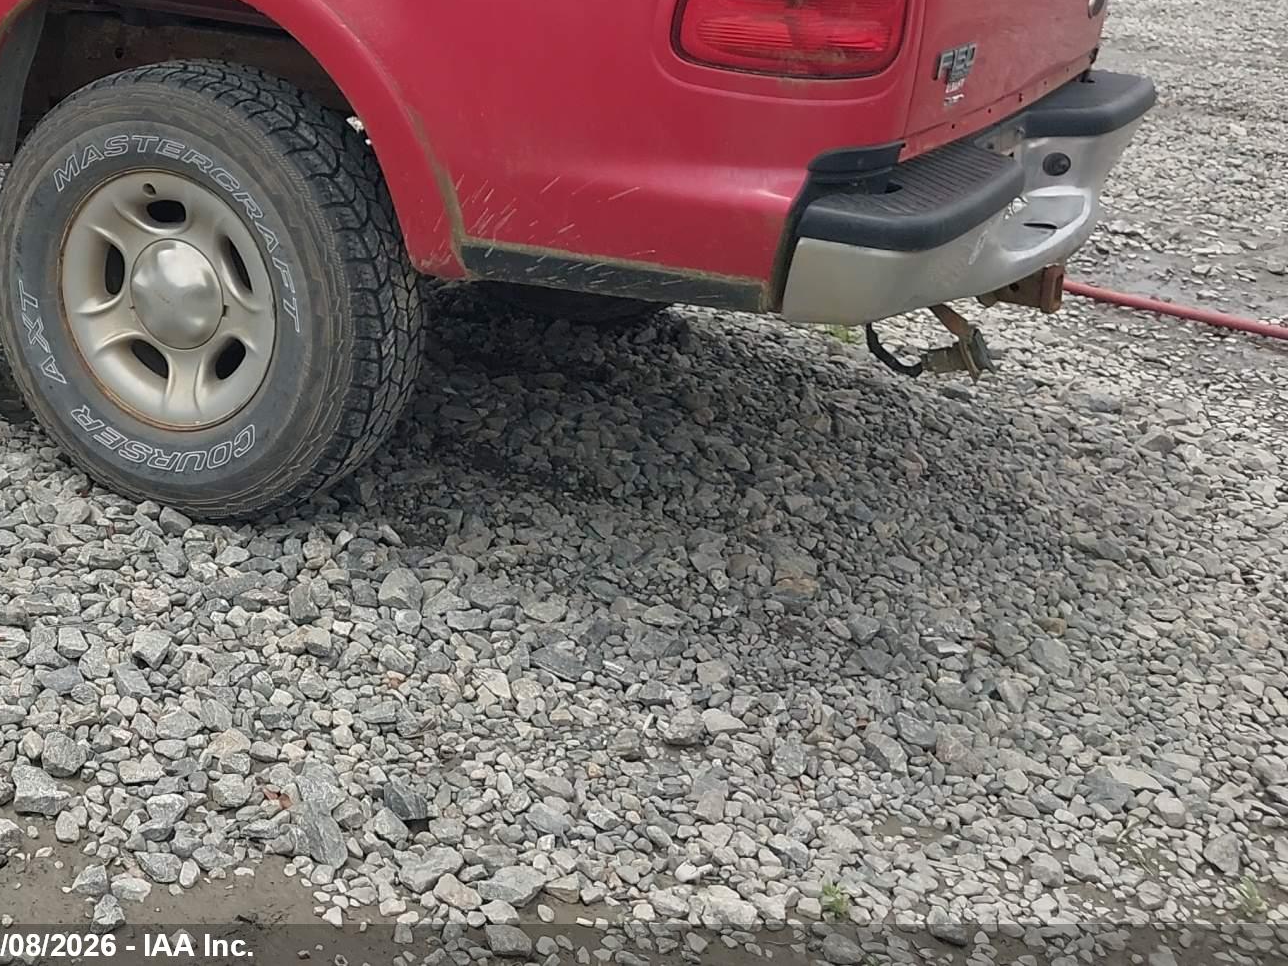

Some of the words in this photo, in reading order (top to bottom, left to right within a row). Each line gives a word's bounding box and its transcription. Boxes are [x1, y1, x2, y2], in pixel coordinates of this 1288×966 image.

[52, 134, 301, 334] MASTERCRAFT
[17, 279, 67, 385] AXT
[70, 404, 257, 472] COURSER
